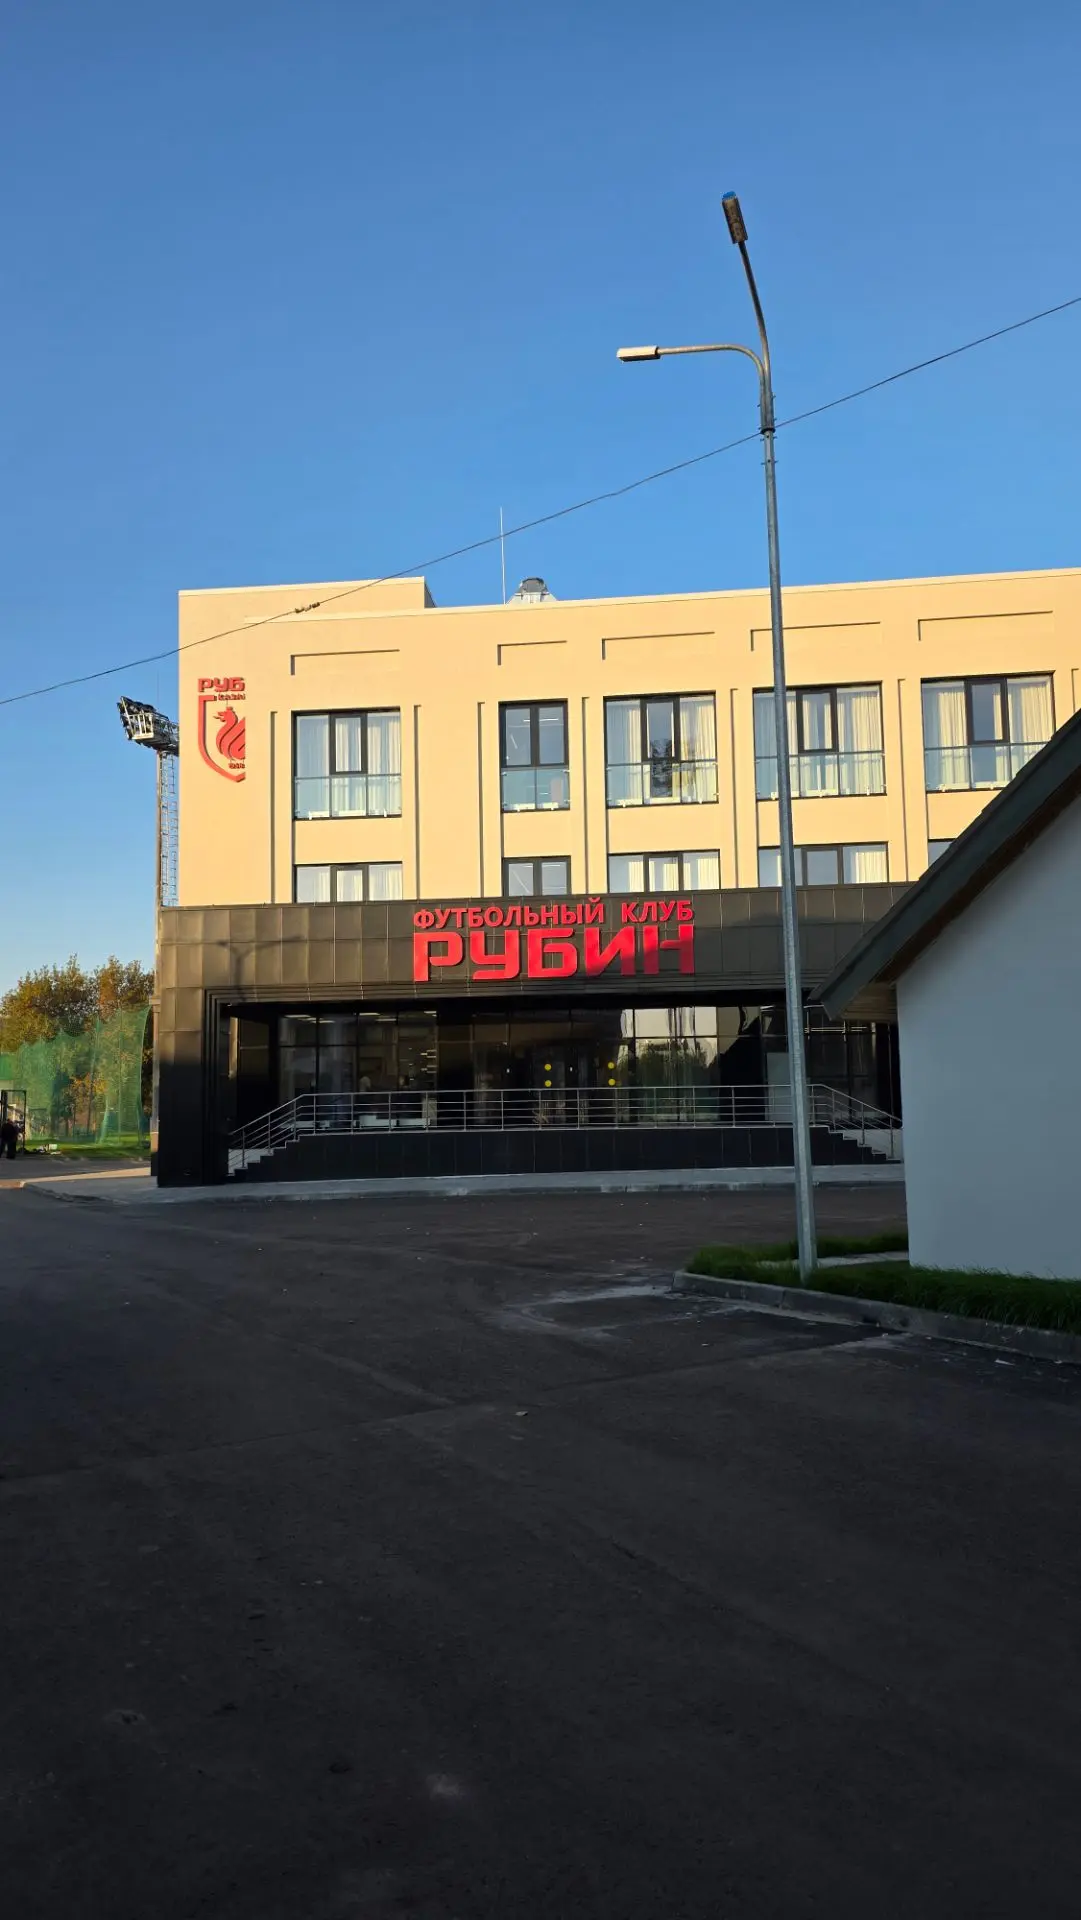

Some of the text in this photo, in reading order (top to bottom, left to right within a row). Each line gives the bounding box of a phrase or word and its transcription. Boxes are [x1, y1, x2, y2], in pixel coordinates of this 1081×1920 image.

[413, 897, 694, 929] ФУТБОЛЬНЫЙ КЛУБ
[413, 924, 695, 982] РУБИН
